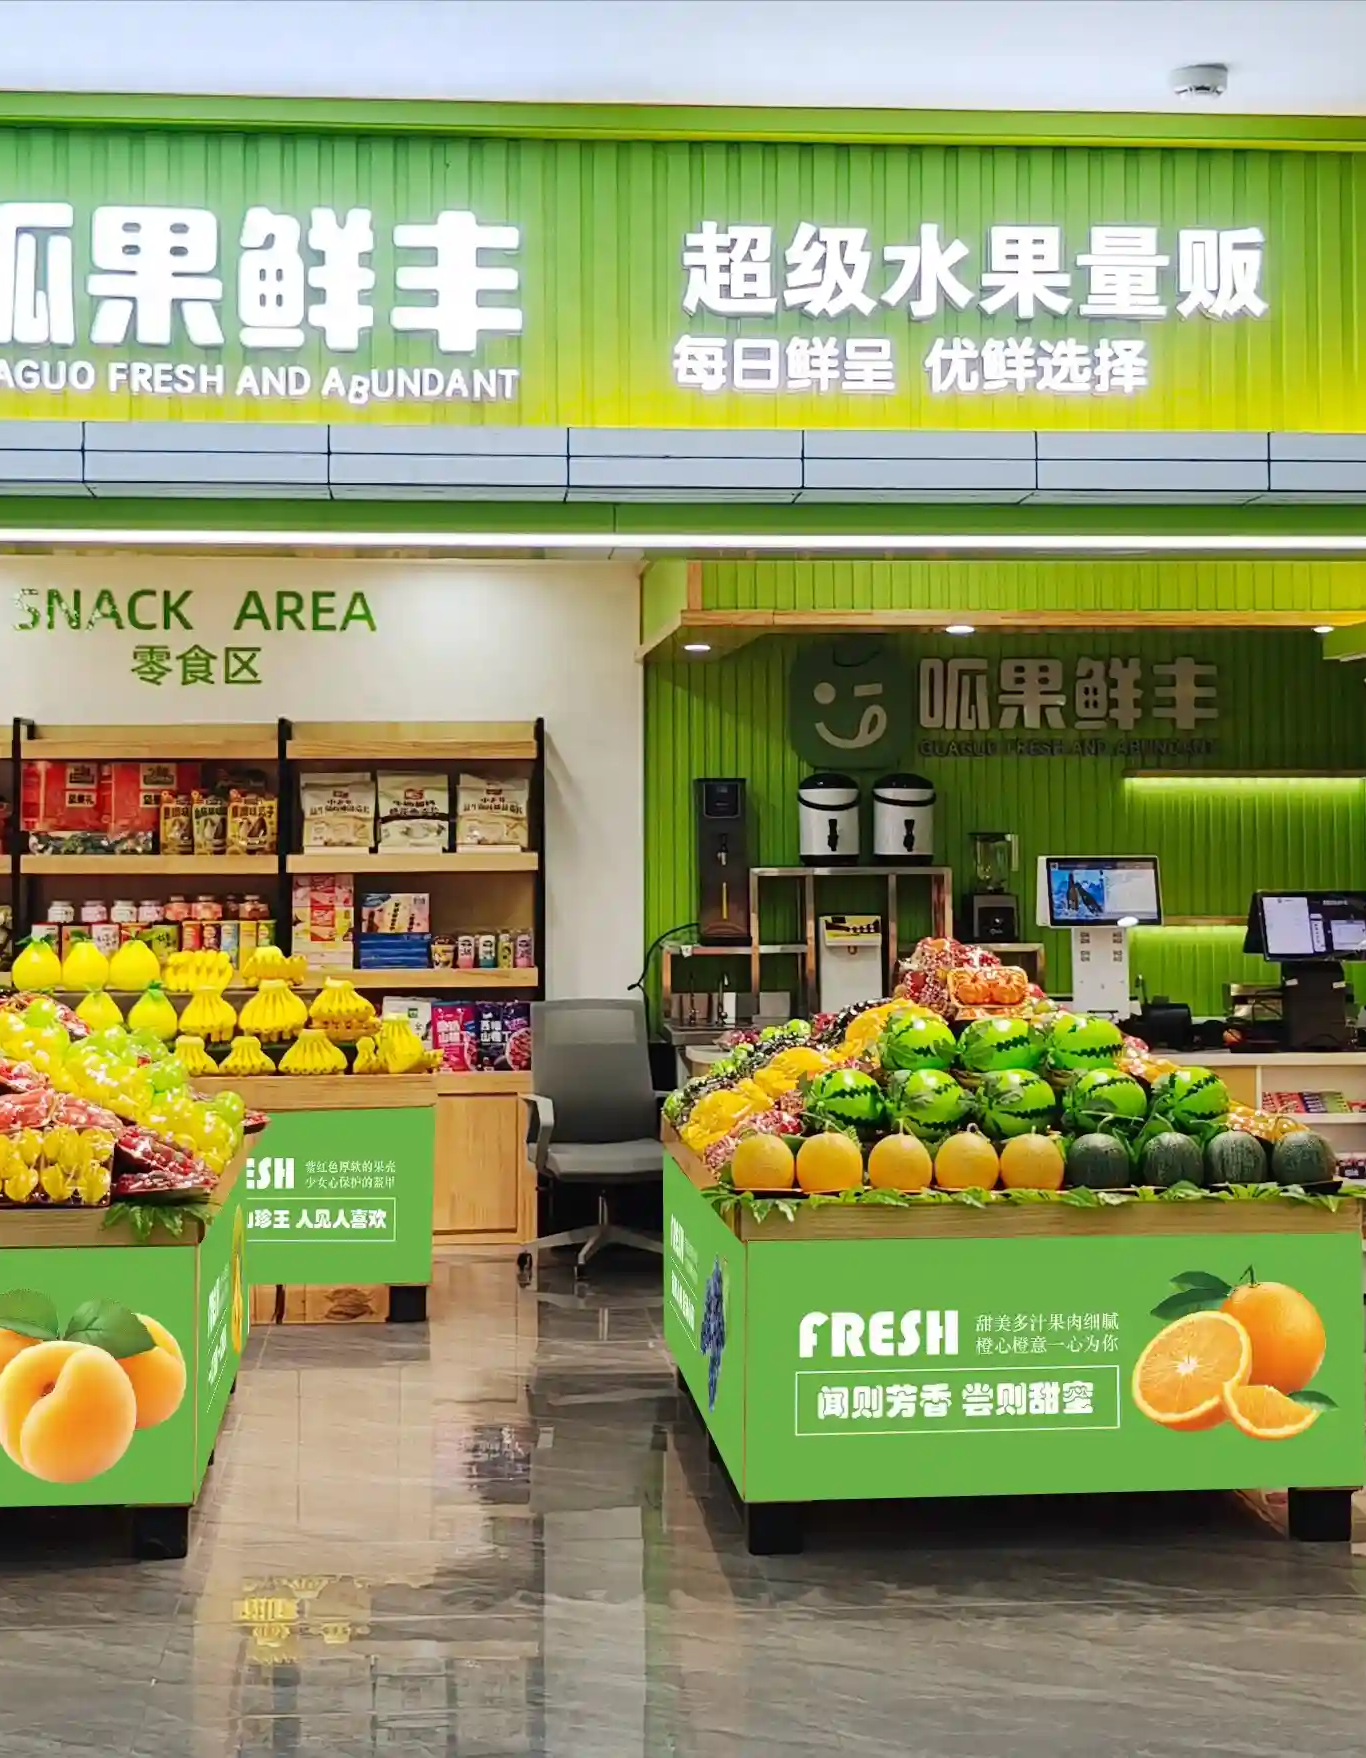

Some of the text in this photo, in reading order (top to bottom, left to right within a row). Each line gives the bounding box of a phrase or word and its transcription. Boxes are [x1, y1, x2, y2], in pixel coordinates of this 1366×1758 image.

[681, 220, 1270, 321] 超级水果量贩
[108, 361, 222, 395] FRESH
[235, 364, 311, 398] AND
[321, 367, 520, 405] ABUNDANT
[672, 335, 1149, 395] 每日鲜呈 优鲜选择
[13, 588, 377, 632] SNACK AREA
[131, 644, 264, 687] 零食区
[918, 657, 1219, 732] 呱果鲜丰
[296, 1208, 387, 1230] 人见人喜欢
[798, 1309, 960, 1358] FRESH
[975, 1312, 1120, 1333] 甜美多汁果肉细腻
[975, 1334, 1120, 1357] 橙心橙意一心为你
[817, 1380, 1095, 1421] 闻则芳香 尝则甜蜜
